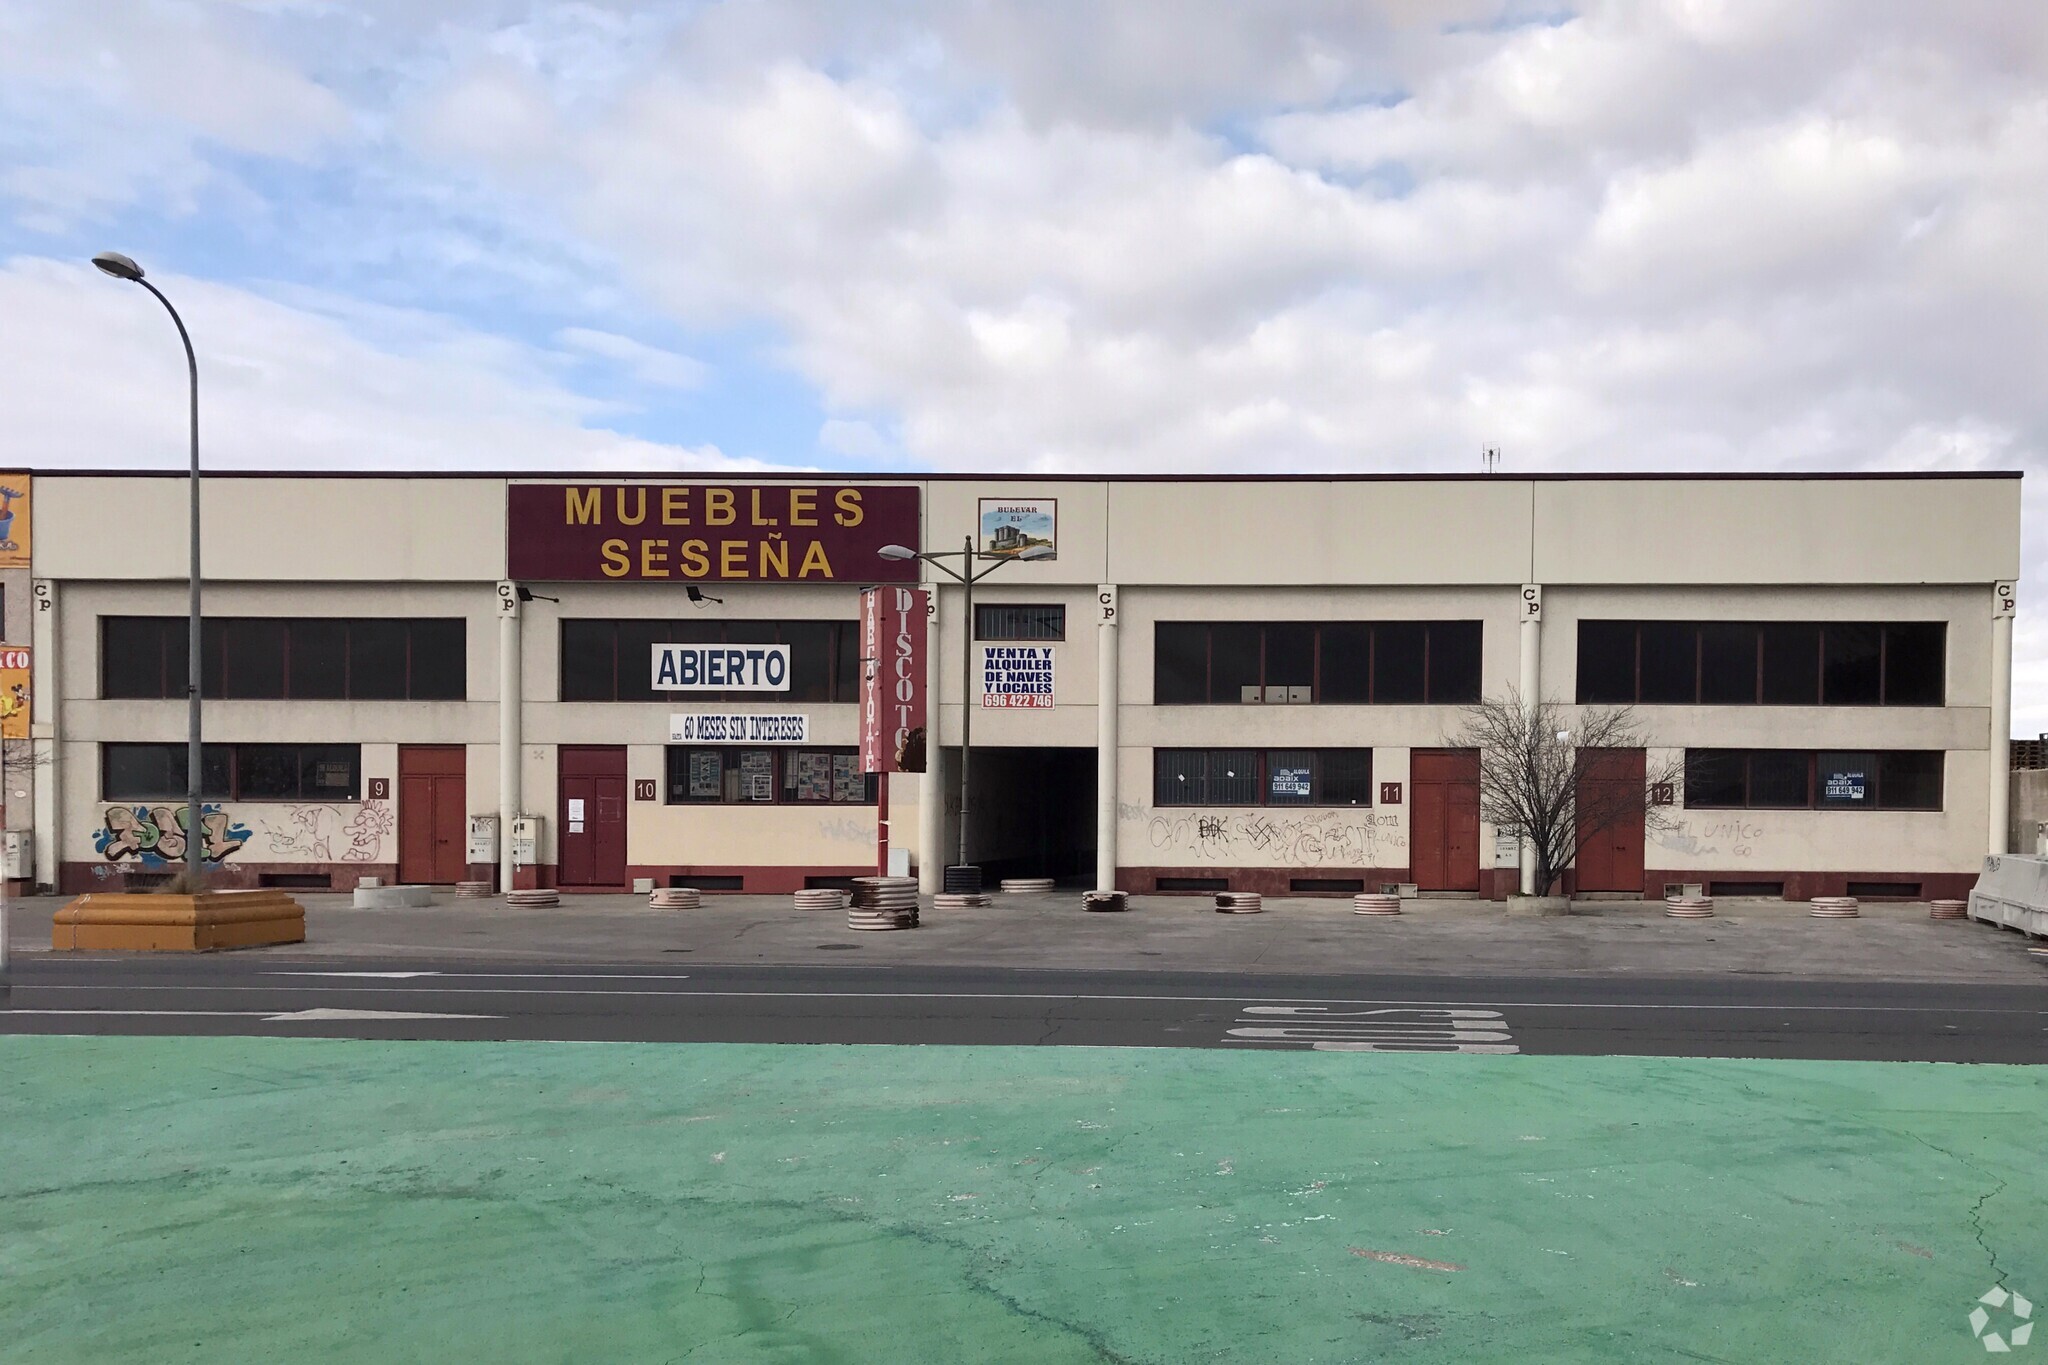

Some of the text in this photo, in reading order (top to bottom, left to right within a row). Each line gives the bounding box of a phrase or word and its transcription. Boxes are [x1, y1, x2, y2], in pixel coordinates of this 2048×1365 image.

[565, 487, 864, 527] MUEBLES
[997, 506, 1038, 514] BULEVAR
[1010, 515, 1023, 523] EL
[601, 532, 834, 578] SESEÑA
[985, 648, 1052, 659] VENTA Y
[657, 648, 785, 687] ABIERTO
[985, 660, 1052, 671] ALQUILER
[985, 671, 1052, 682] DE NAVES
[985, 683, 1052, 693] Y LOCALES
[985, 695, 1052, 707] 696 422 746
[685, 716, 695, 740] 60
[697, 716, 726, 741] MESES
[729, 716, 747, 741] SIN
[750, 716, 803, 741] INTERESES
[375, 781, 384, 795] 9
[637, 783, 654, 797] 10
[1383, 786, 1400, 801] 11
[1654, 787, 1671, 803] 12
